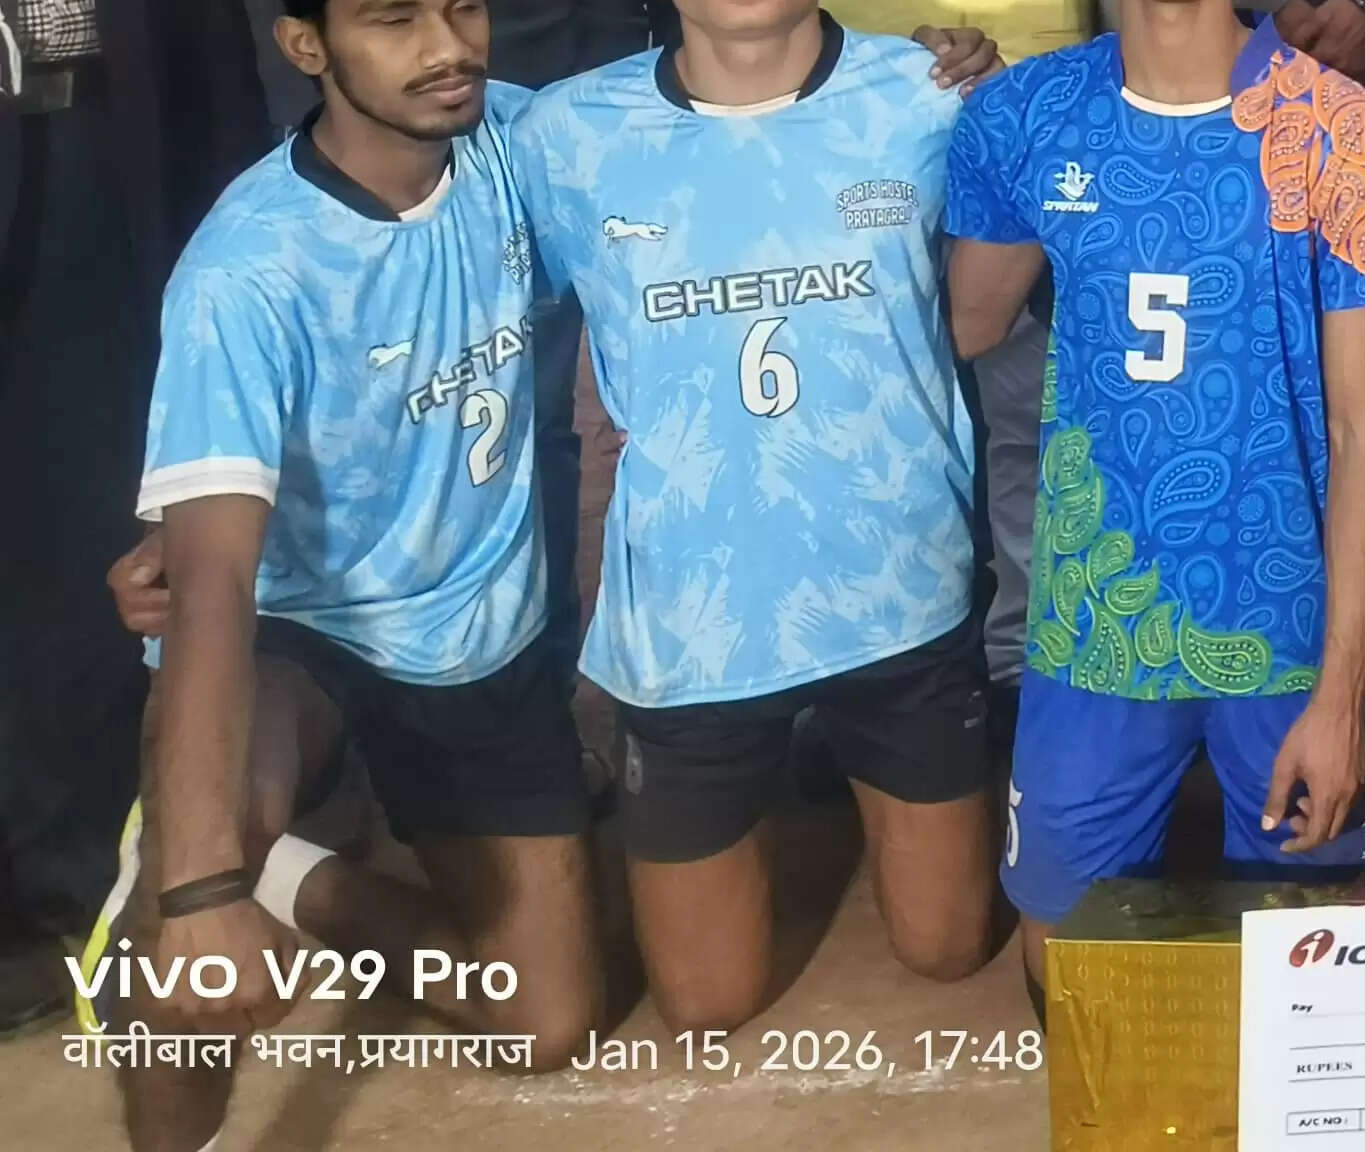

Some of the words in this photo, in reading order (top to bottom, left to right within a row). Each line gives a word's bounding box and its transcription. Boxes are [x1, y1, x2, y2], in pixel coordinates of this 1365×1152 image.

[836, 179, 878, 213] SPORTS
[643, 259, 874, 322] CHETAK
[1125, 273, 1190, 382] 5
[738, 317, 801, 418] 6
[459, 388, 510, 487] 2
[1291, 1003, 1313, 1013] Pay
[1297, 1061, 1353, 1073] RUPEES
